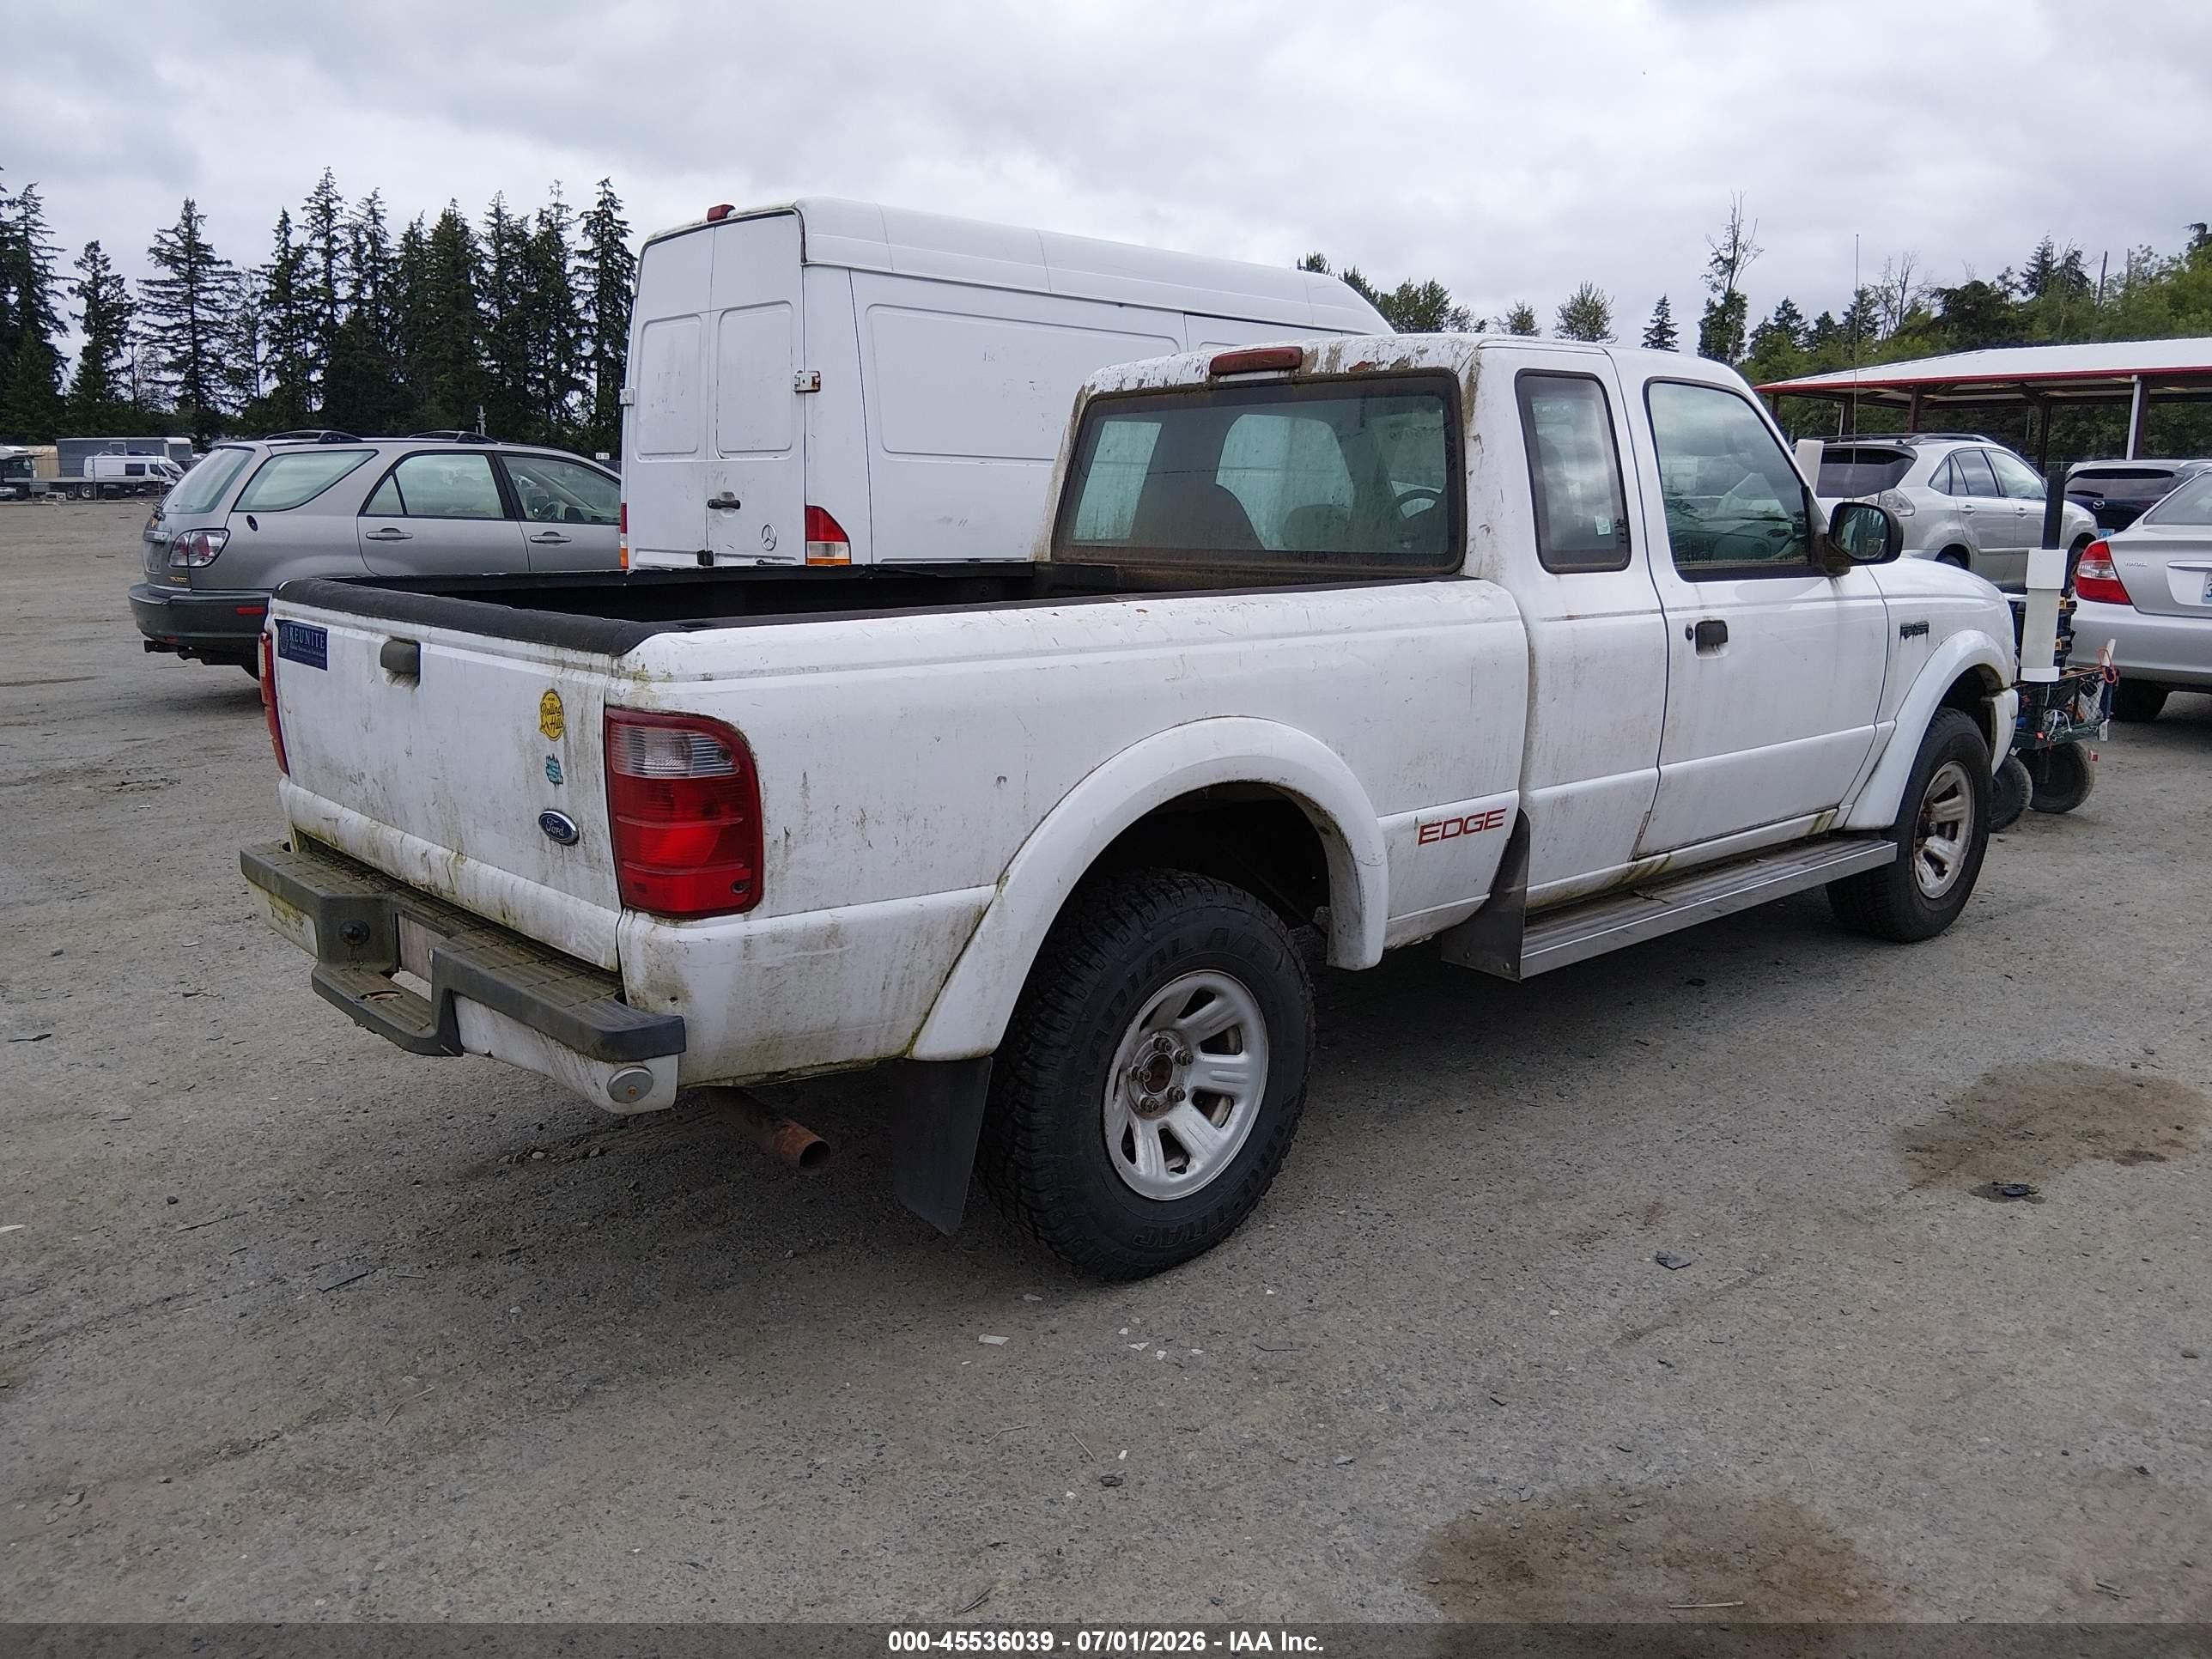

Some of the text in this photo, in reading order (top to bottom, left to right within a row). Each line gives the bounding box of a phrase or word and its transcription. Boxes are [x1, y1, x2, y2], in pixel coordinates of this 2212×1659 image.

[289, 626, 325, 649] REUNITE
[545, 817, 564, 836] Ford
[1418, 808, 1507, 846] EDGE
